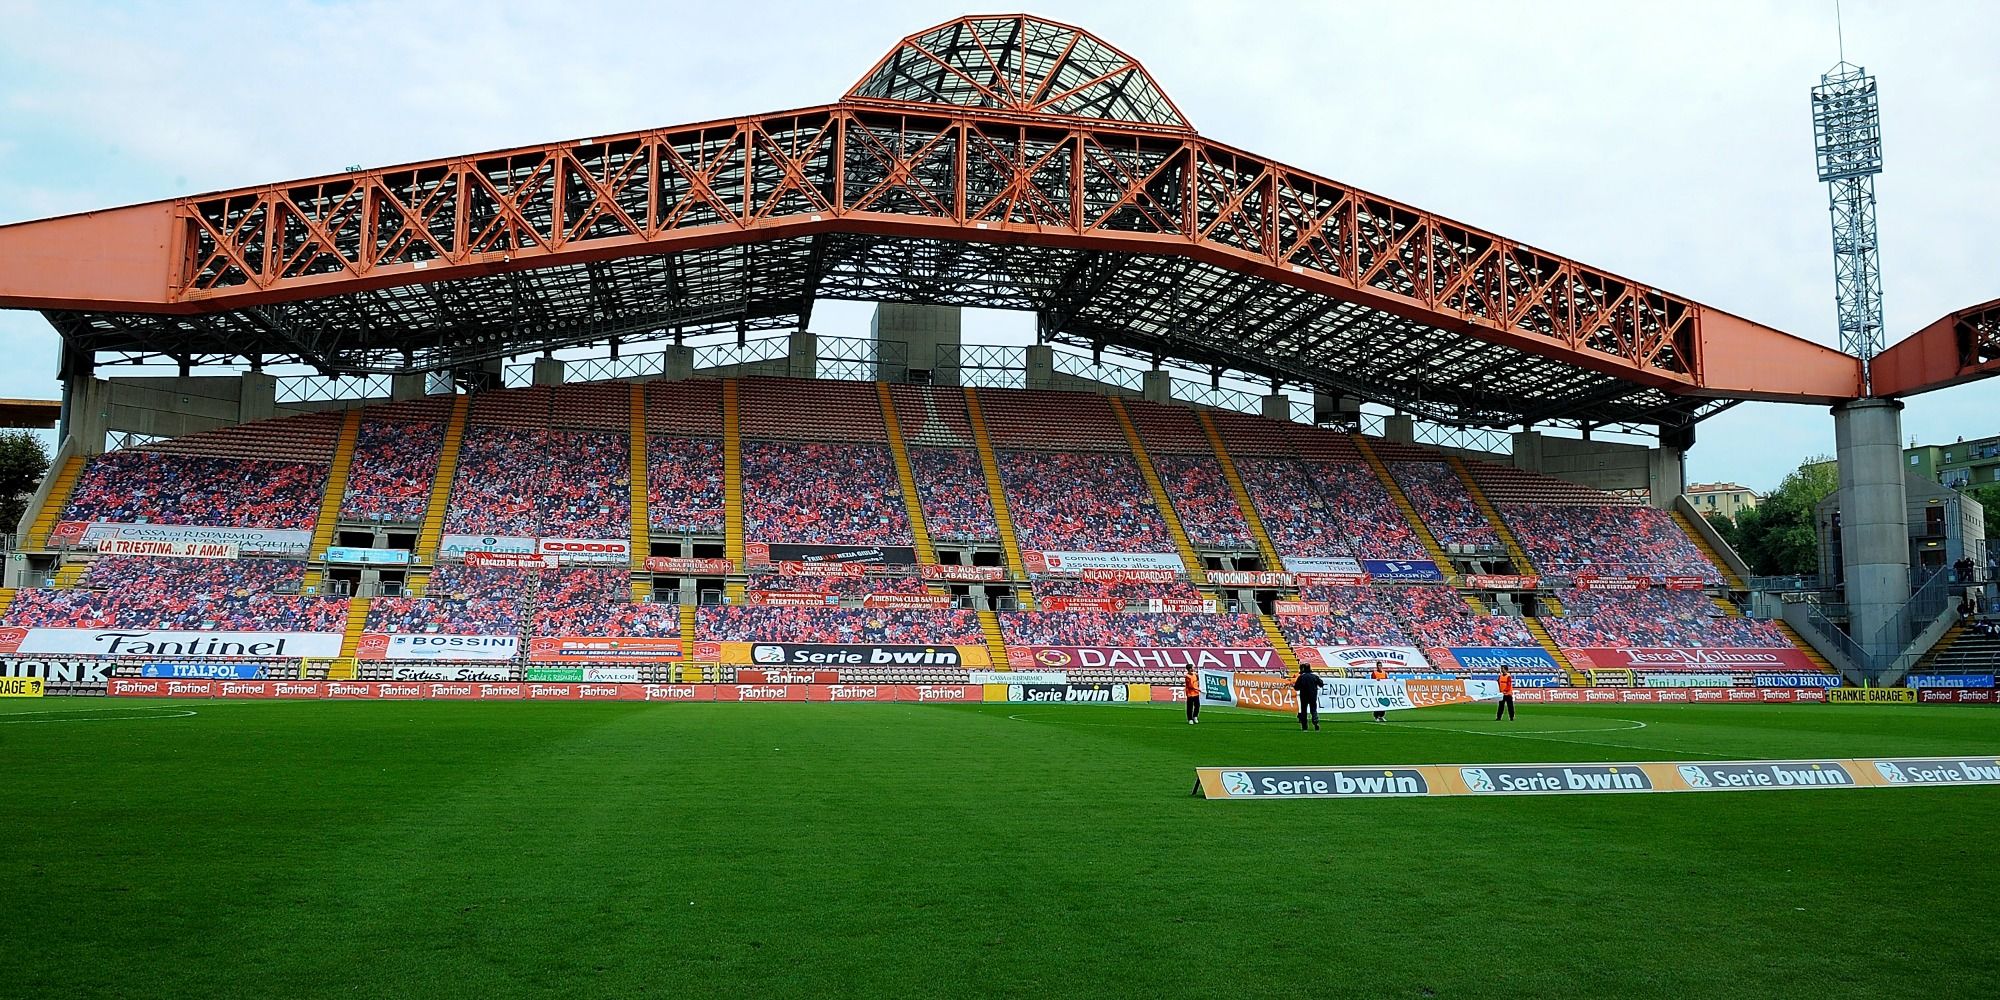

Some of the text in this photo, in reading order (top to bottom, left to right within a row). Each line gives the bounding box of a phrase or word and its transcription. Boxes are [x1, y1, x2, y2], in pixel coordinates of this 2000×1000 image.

[122, 528, 166, 536] CASSA
[183, 530, 263, 540] RISPARMIO
[100, 540, 112, 552] LA
[116, 540, 181, 555] TRIESTINA...
[186, 544, 197, 555] SI
[199, 545, 229, 556] AMA!
[957, 566, 982, 574] MULE
[1084, 570, 1173, 581] MILANO ALABARDATA
[1163, 604, 1176, 613] BAR
[1179, 605, 1203, 613] JUNIOR
[96, 632, 286, 656] Fantinel
[412, 637, 514, 646] BOSSINI
[793, 648, 957, 665] Serie bwin
[1339, 649, 1404, 661] sterilgarda
[1461, 656, 1549, 665] PALMANOVA
[1616, 649, 1675, 664] Testa
[1673, 649, 1777, 664] Molinaro
[173, 664, 239, 677] ITALPOL
[396, 668, 442, 681] Sixtus
[455, 669, 500, 681] Sixtus
[761, 671, 816, 683] Fantinel
[1207, 676, 1220, 685] FAI
[1235, 679, 1260, 688] MANDA
[1757, 676, 1840, 688] BRUNO BRUNO
[115, 681, 159, 695] Fantinel
[168, 681, 211, 695] Fantinel
[221, 681, 265, 695] Fantinel
[272, 682, 317, 697] Fantinel
[325, 683, 370, 697] Fantinel
[376, 683, 421, 697] Fantinel
[429, 684, 472, 698] Fantinel
[479, 684, 521, 698] Fantinel
[529, 685, 570, 698] Fantinel
[577, 685, 618, 698] Fantinel
[641, 685, 696, 700] Fantinel
[736, 684, 788, 701] Fantinel
[828, 685, 877, 701] Fantinel
[915, 685, 966, 702] Fantinel
[1027, 685, 1110, 701] Serie bwin
[1321, 684, 1405, 697] ENDI L'ITALIA
[1408, 684, 1430, 692] MANDA
[1726, 688, 1756, 701] Fantinel
[1760, 688, 1791, 701] Fantinel
[1793, 688, 1823, 701] Fantinel
[1239, 687, 1296, 707] 45504
[1549, 689, 1579, 701] Fantinel
[1584, 689, 1616, 701] Fantinel
[1620, 690, 1651, 702] Fantinel
[1656, 690, 1687, 702] Fantinel
[1690, 689, 1723, 702] Fantinel
[1831, 690, 1904, 701] FRANKIE GARAGE
[1922, 690, 1952, 702] Fantinel
[1957, 690, 1989, 702] Fantinel
[1329, 697, 1356, 709] TUO
[1499, 768, 1643, 791] Serie bwin
[1716, 764, 1844, 786] Serie bwin
[1907, 766, 1962, 783] Serie
[1261, 771, 1417, 794] Serie bwin
